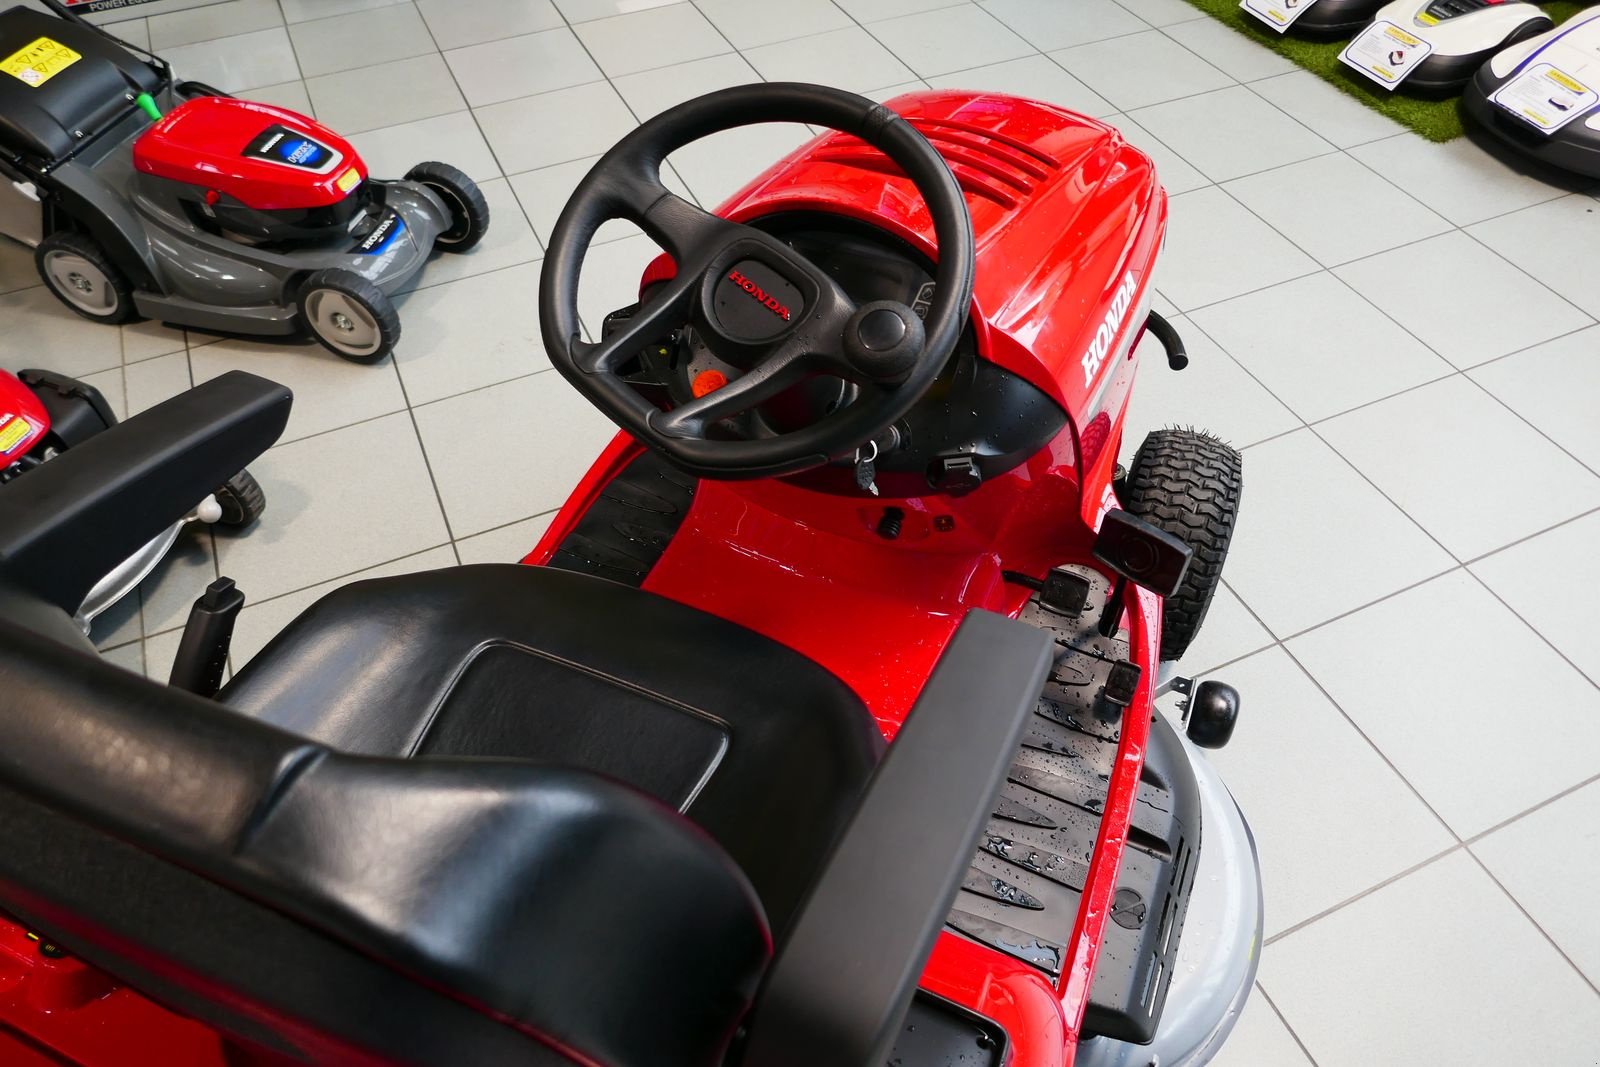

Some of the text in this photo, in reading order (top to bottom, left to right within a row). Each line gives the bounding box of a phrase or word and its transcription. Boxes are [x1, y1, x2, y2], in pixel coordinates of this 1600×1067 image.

[89, 0, 127, 12] POWER
[362, 219, 393, 249] HONDA
[728, 270, 791, 321] HONDA
[1081, 269, 1137, 389] HONDA
